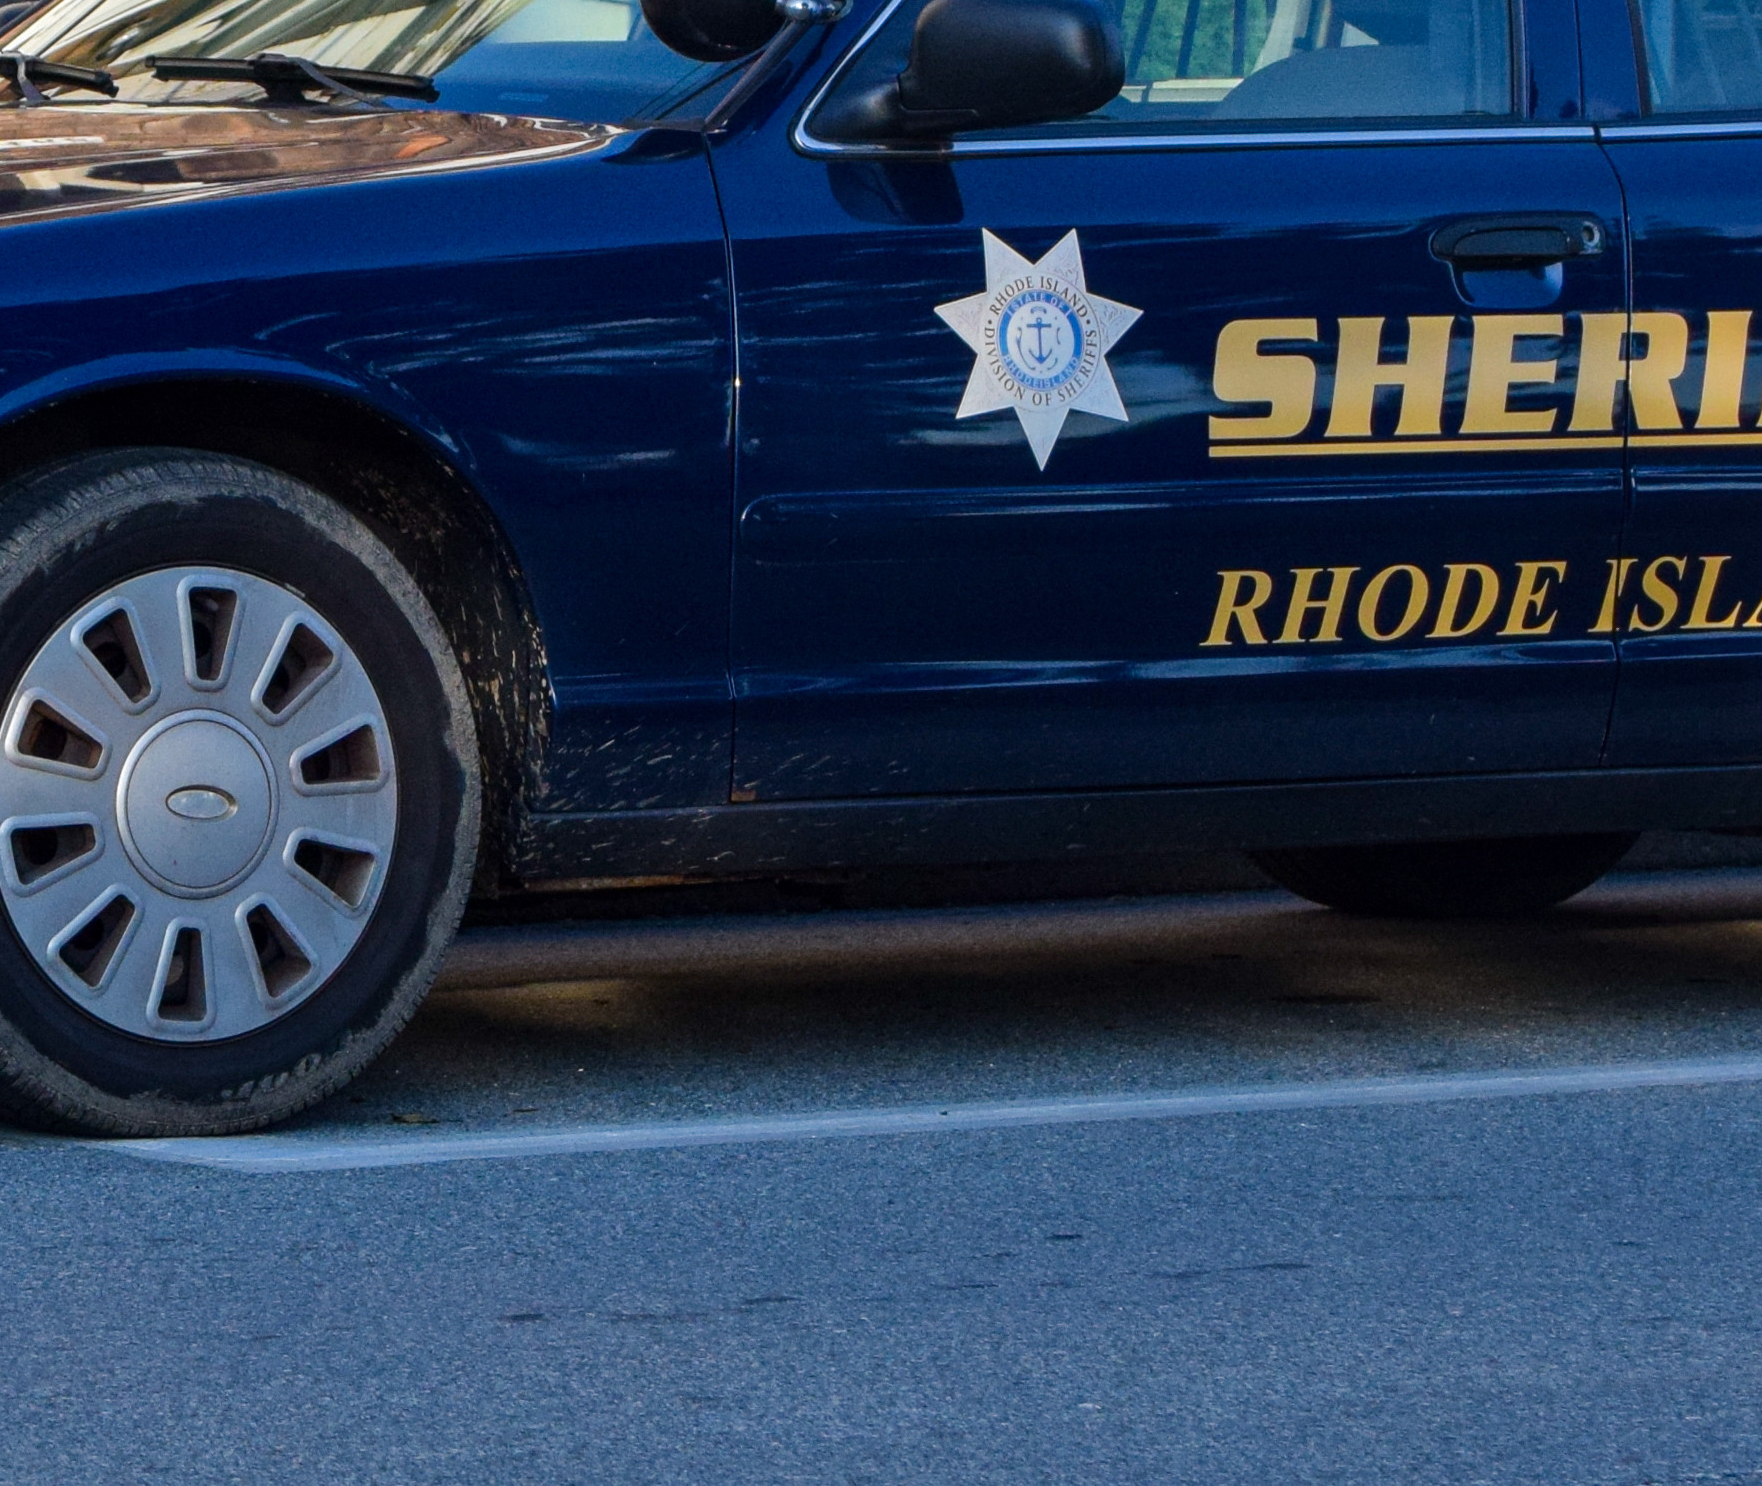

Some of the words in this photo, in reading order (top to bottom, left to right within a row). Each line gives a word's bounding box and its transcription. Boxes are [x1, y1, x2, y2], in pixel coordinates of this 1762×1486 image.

[989, 275, 1034, 316] RHODE
[1040, 276, 1088, 318] ISLAND
[985, 327, 1026, 400] DIVISION
[1032, 392, 1052, 406] OF
[1057, 329, 1098, 403] SHERIFFS
[1199, 560, 1568, 646] RHODE
